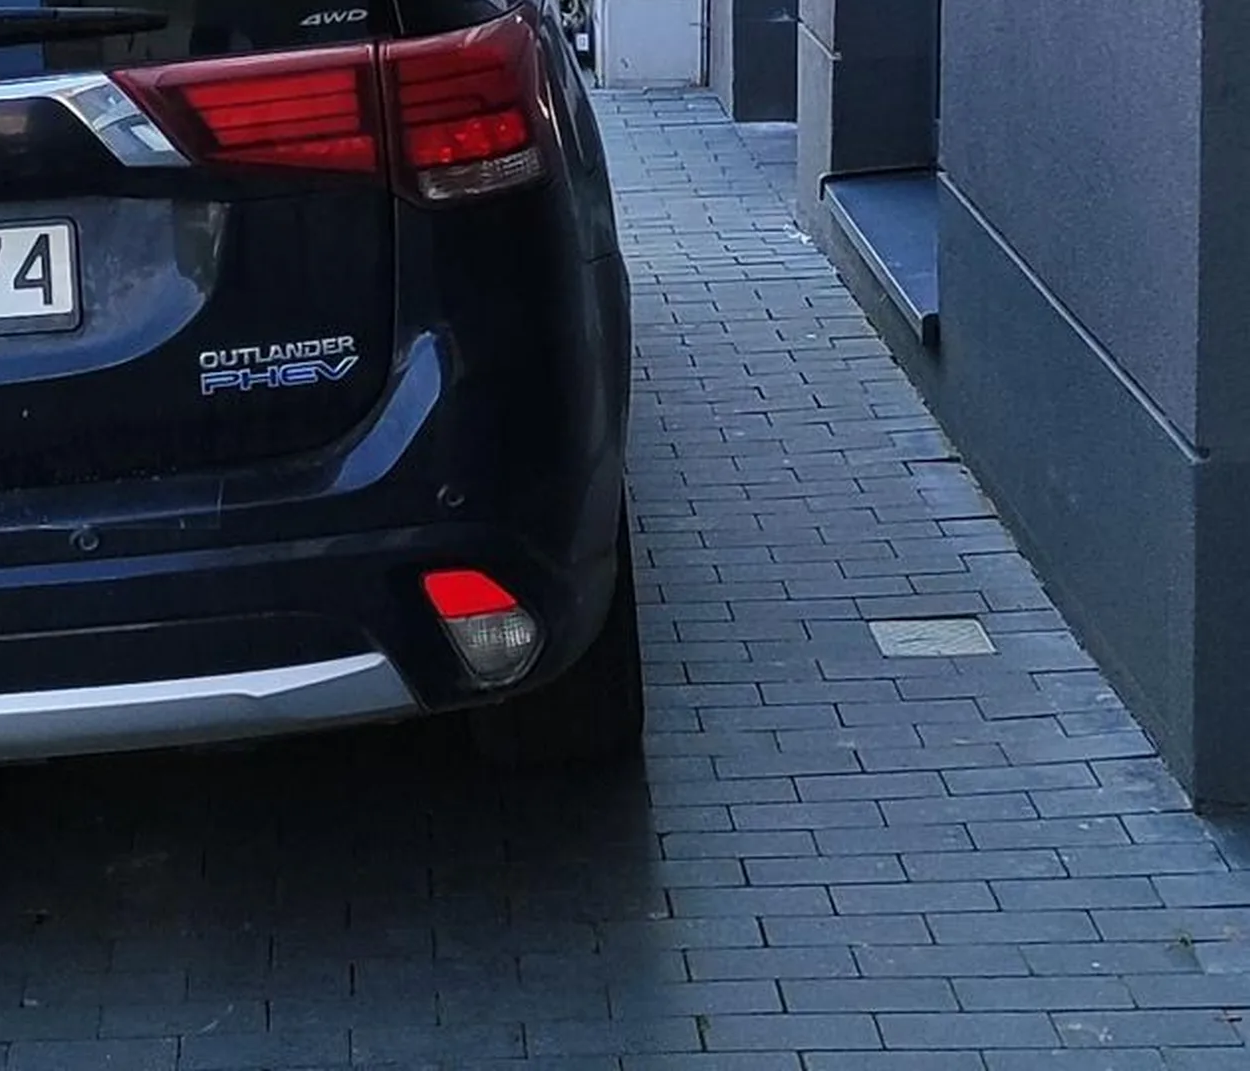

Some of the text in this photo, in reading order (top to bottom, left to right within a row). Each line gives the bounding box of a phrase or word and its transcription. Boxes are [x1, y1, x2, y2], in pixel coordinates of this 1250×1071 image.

[300, 8, 368, 26] 4WD
[200, 335, 356, 368] OUTLANDER
[200, 356, 360, 396] PHEV
